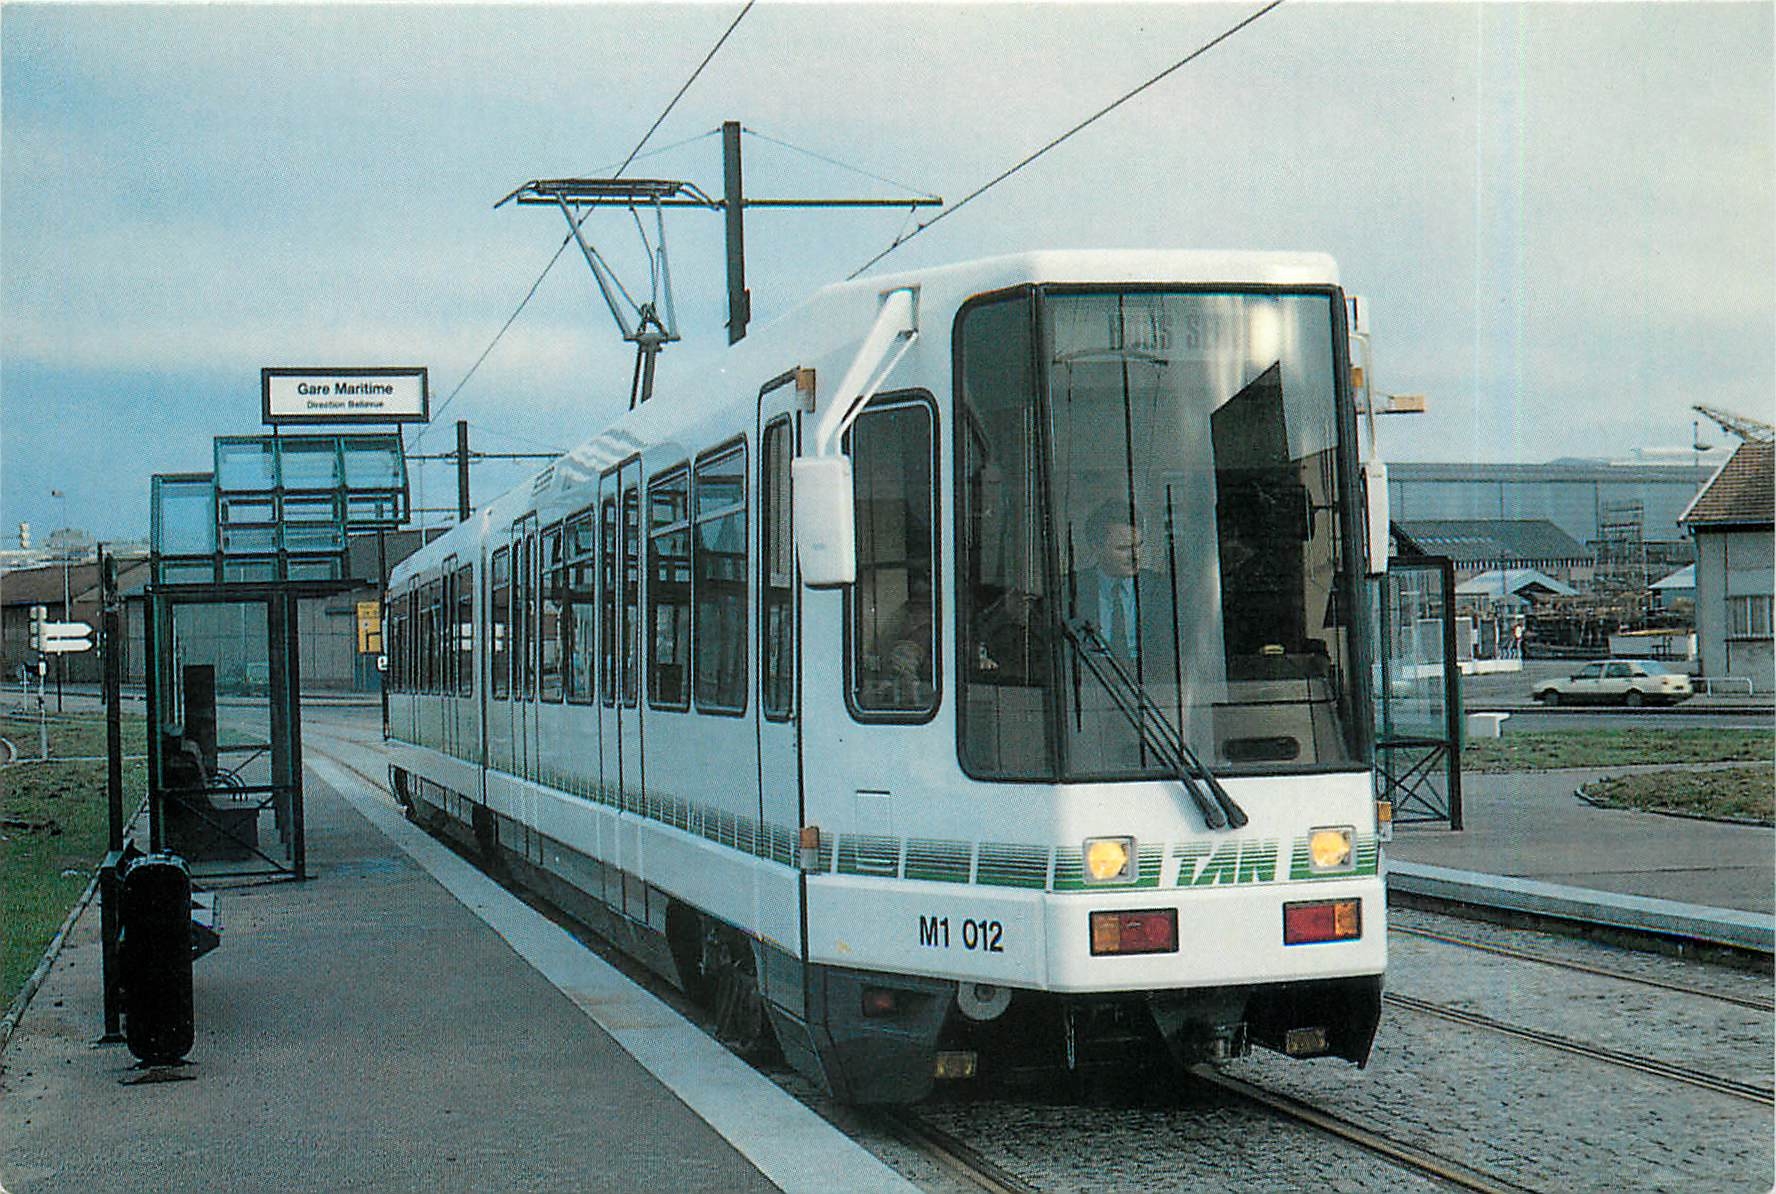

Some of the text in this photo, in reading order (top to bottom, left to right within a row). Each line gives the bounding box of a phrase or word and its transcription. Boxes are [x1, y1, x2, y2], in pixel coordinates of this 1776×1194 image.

[298, 382, 394, 395] Gare Maritime
[307, 400, 384, 408] Direction Bellevue
[1172, 839, 1279, 886] TAN
[919, 915, 1004, 953] M1 012
